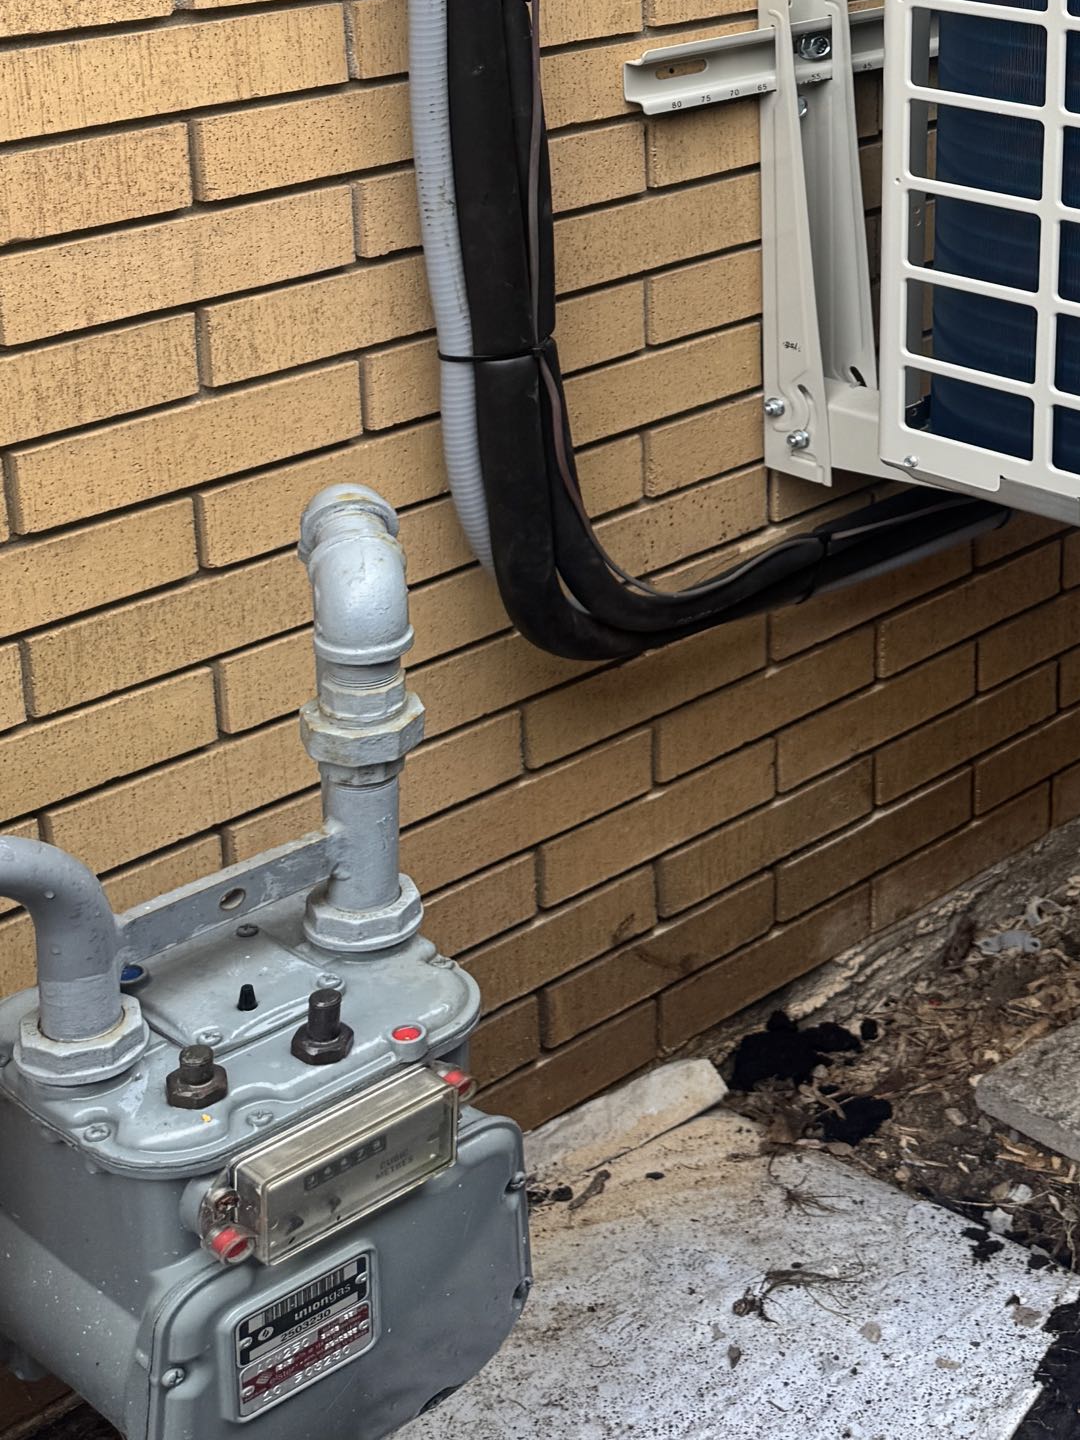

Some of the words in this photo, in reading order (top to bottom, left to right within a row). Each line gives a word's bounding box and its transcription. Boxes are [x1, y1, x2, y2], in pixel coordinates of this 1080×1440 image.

[671, 101, 682, 109] 80
[701, 95, 711, 103] 75
[730, 89, 740, 97] 70
[281, 1309, 331, 1341] 2503230
